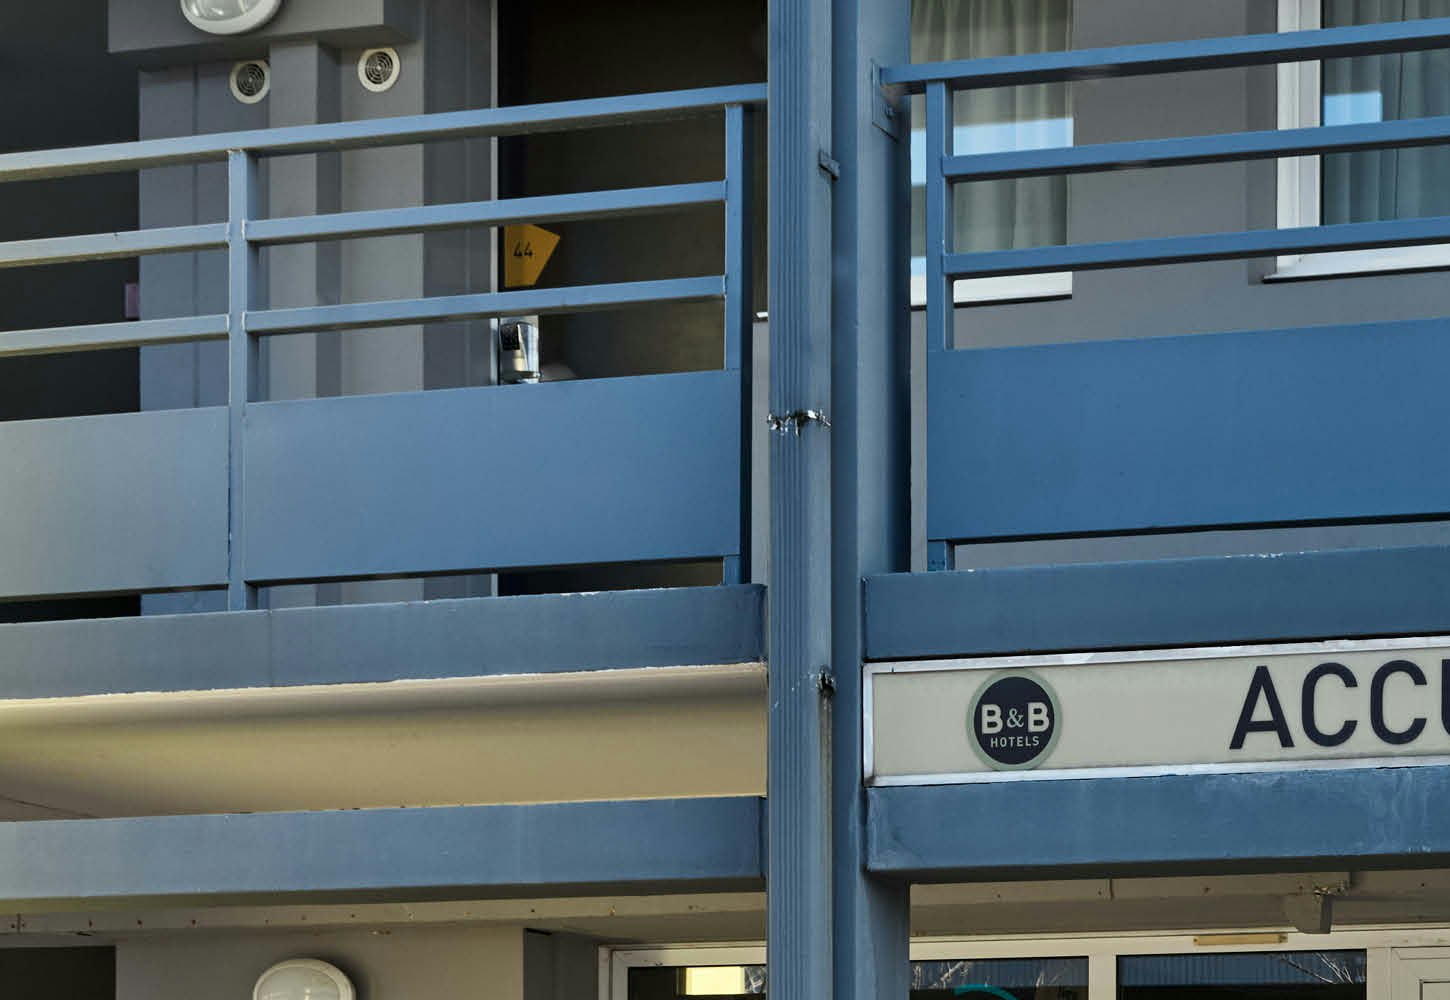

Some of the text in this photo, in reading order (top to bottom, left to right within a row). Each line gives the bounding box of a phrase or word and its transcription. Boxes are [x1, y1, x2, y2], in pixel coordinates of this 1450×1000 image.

[513, 241, 534, 256] 44
[982, 702, 1050, 734] B&B
[990, 736, 1040, 748] HOTELS
